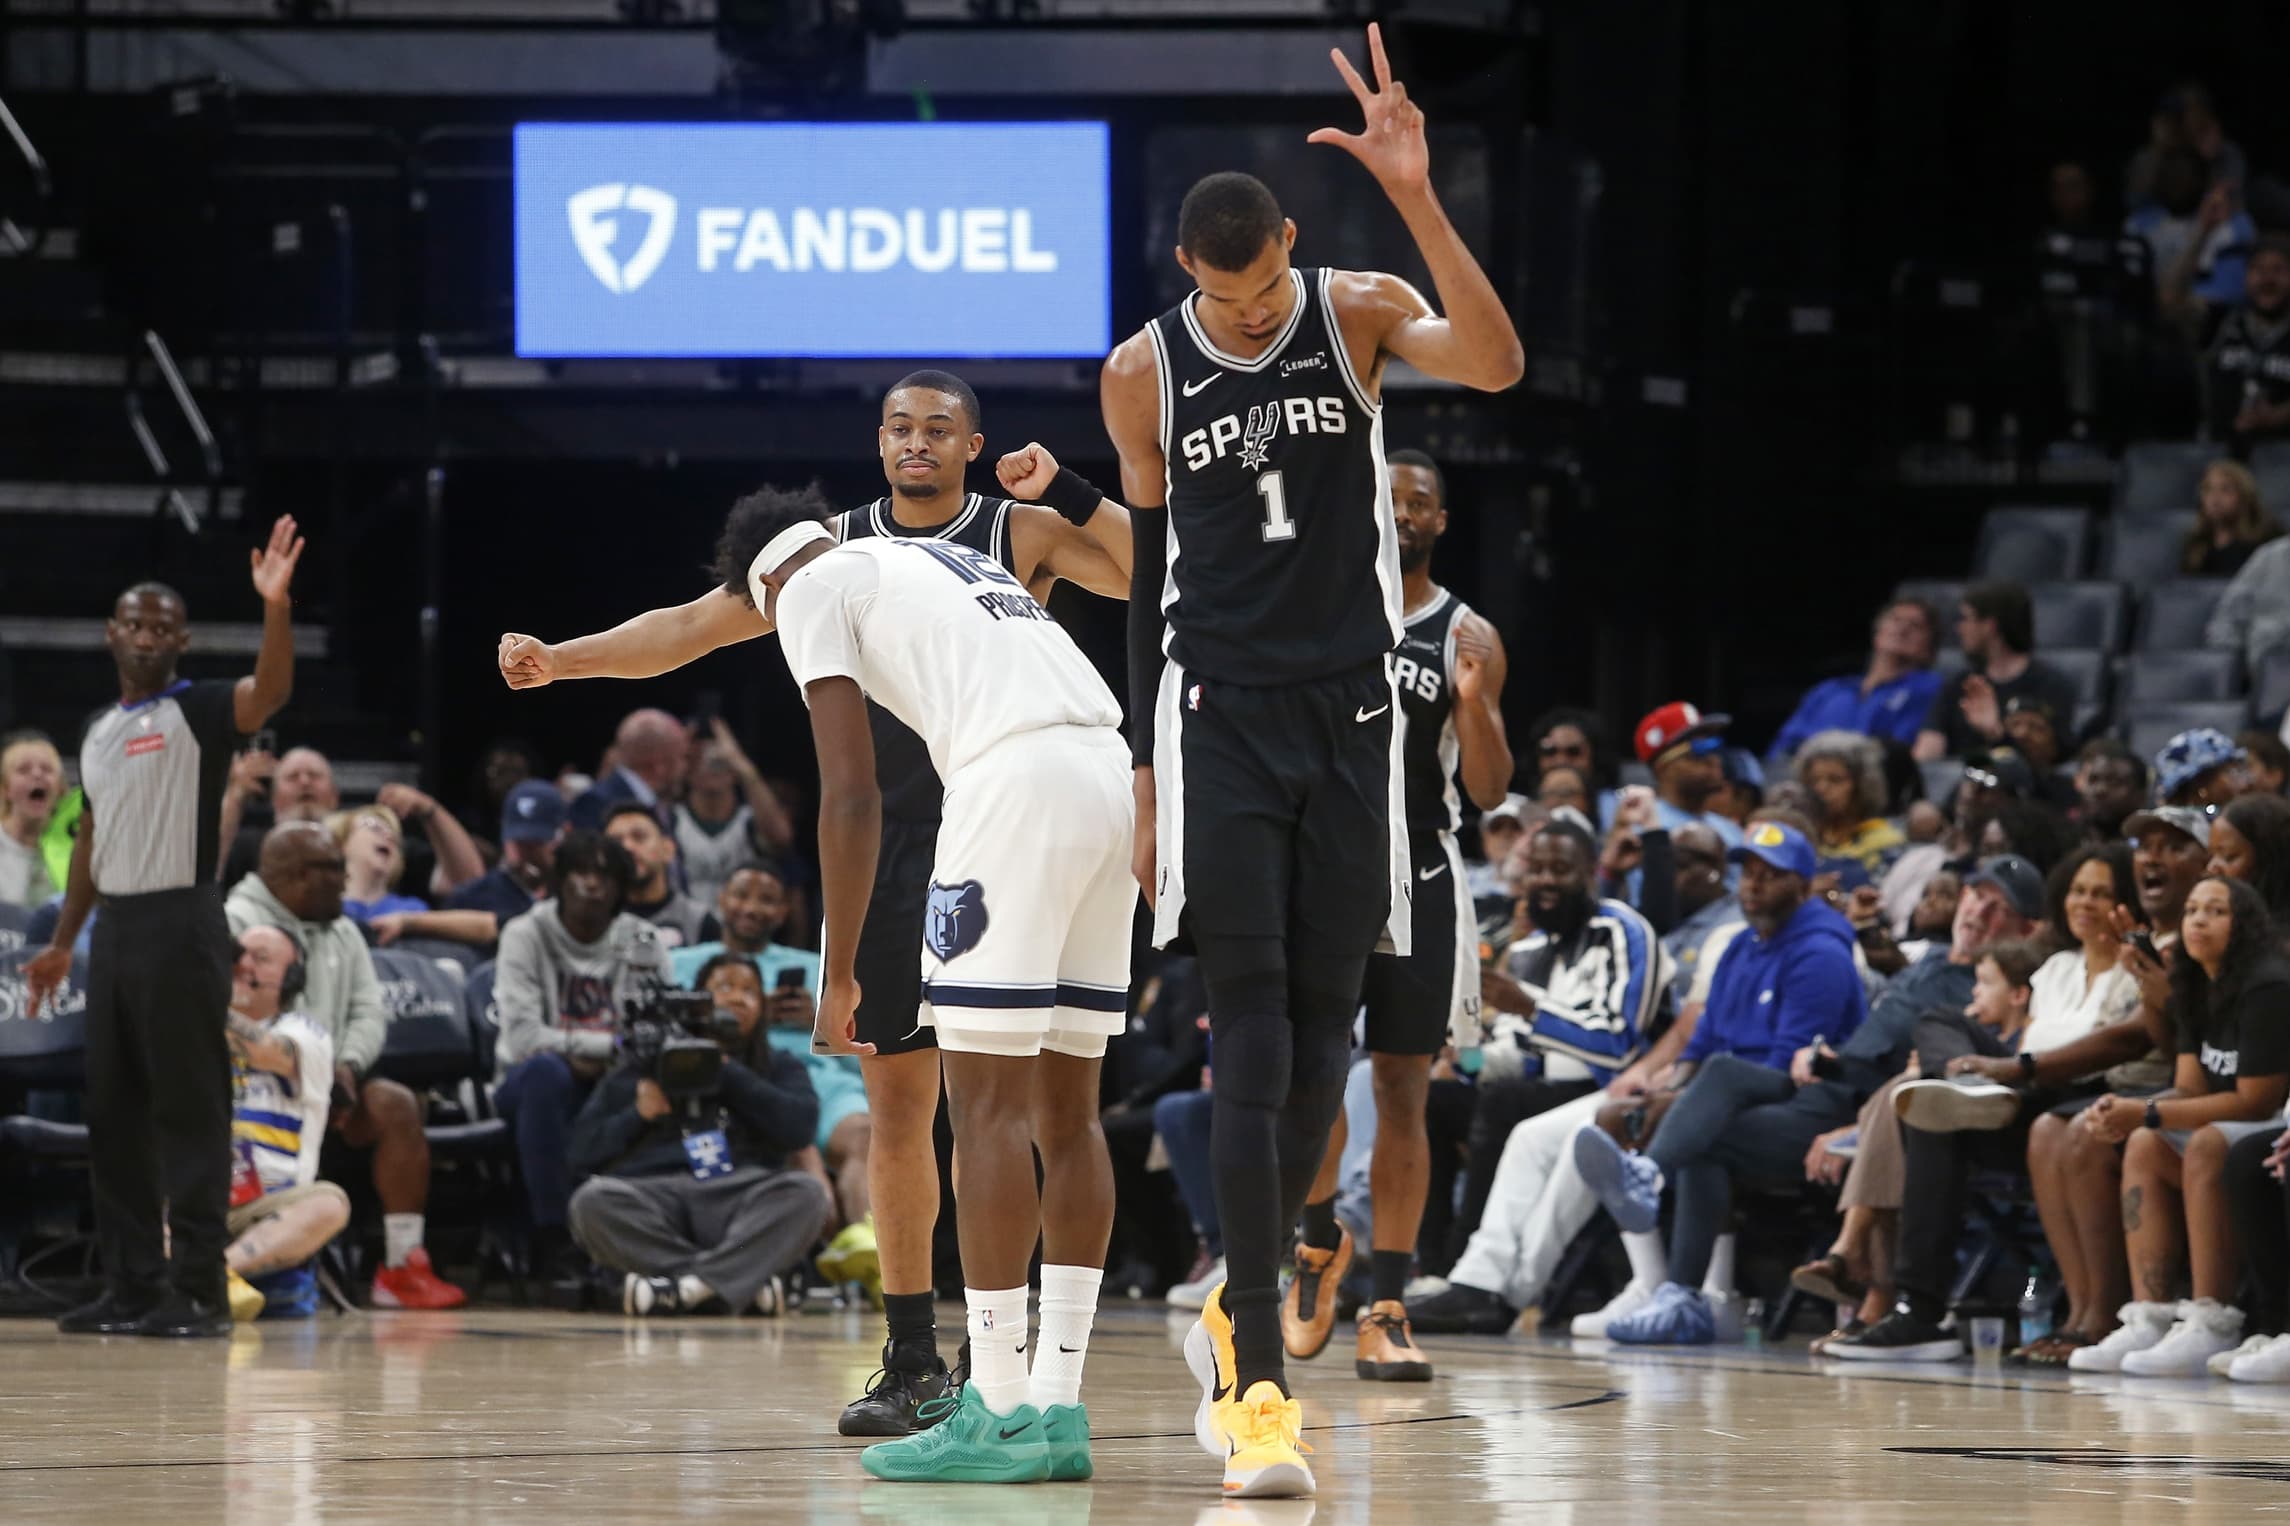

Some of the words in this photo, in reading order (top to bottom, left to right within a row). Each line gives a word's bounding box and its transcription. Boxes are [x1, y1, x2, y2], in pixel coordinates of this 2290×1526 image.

[697, 208, 1057, 272] FANDUEL
[1285, 356, 1321, 371] LEDGER
[1182, 397, 1346, 471] SPURS
[1257, 470, 1296, 542] 1
